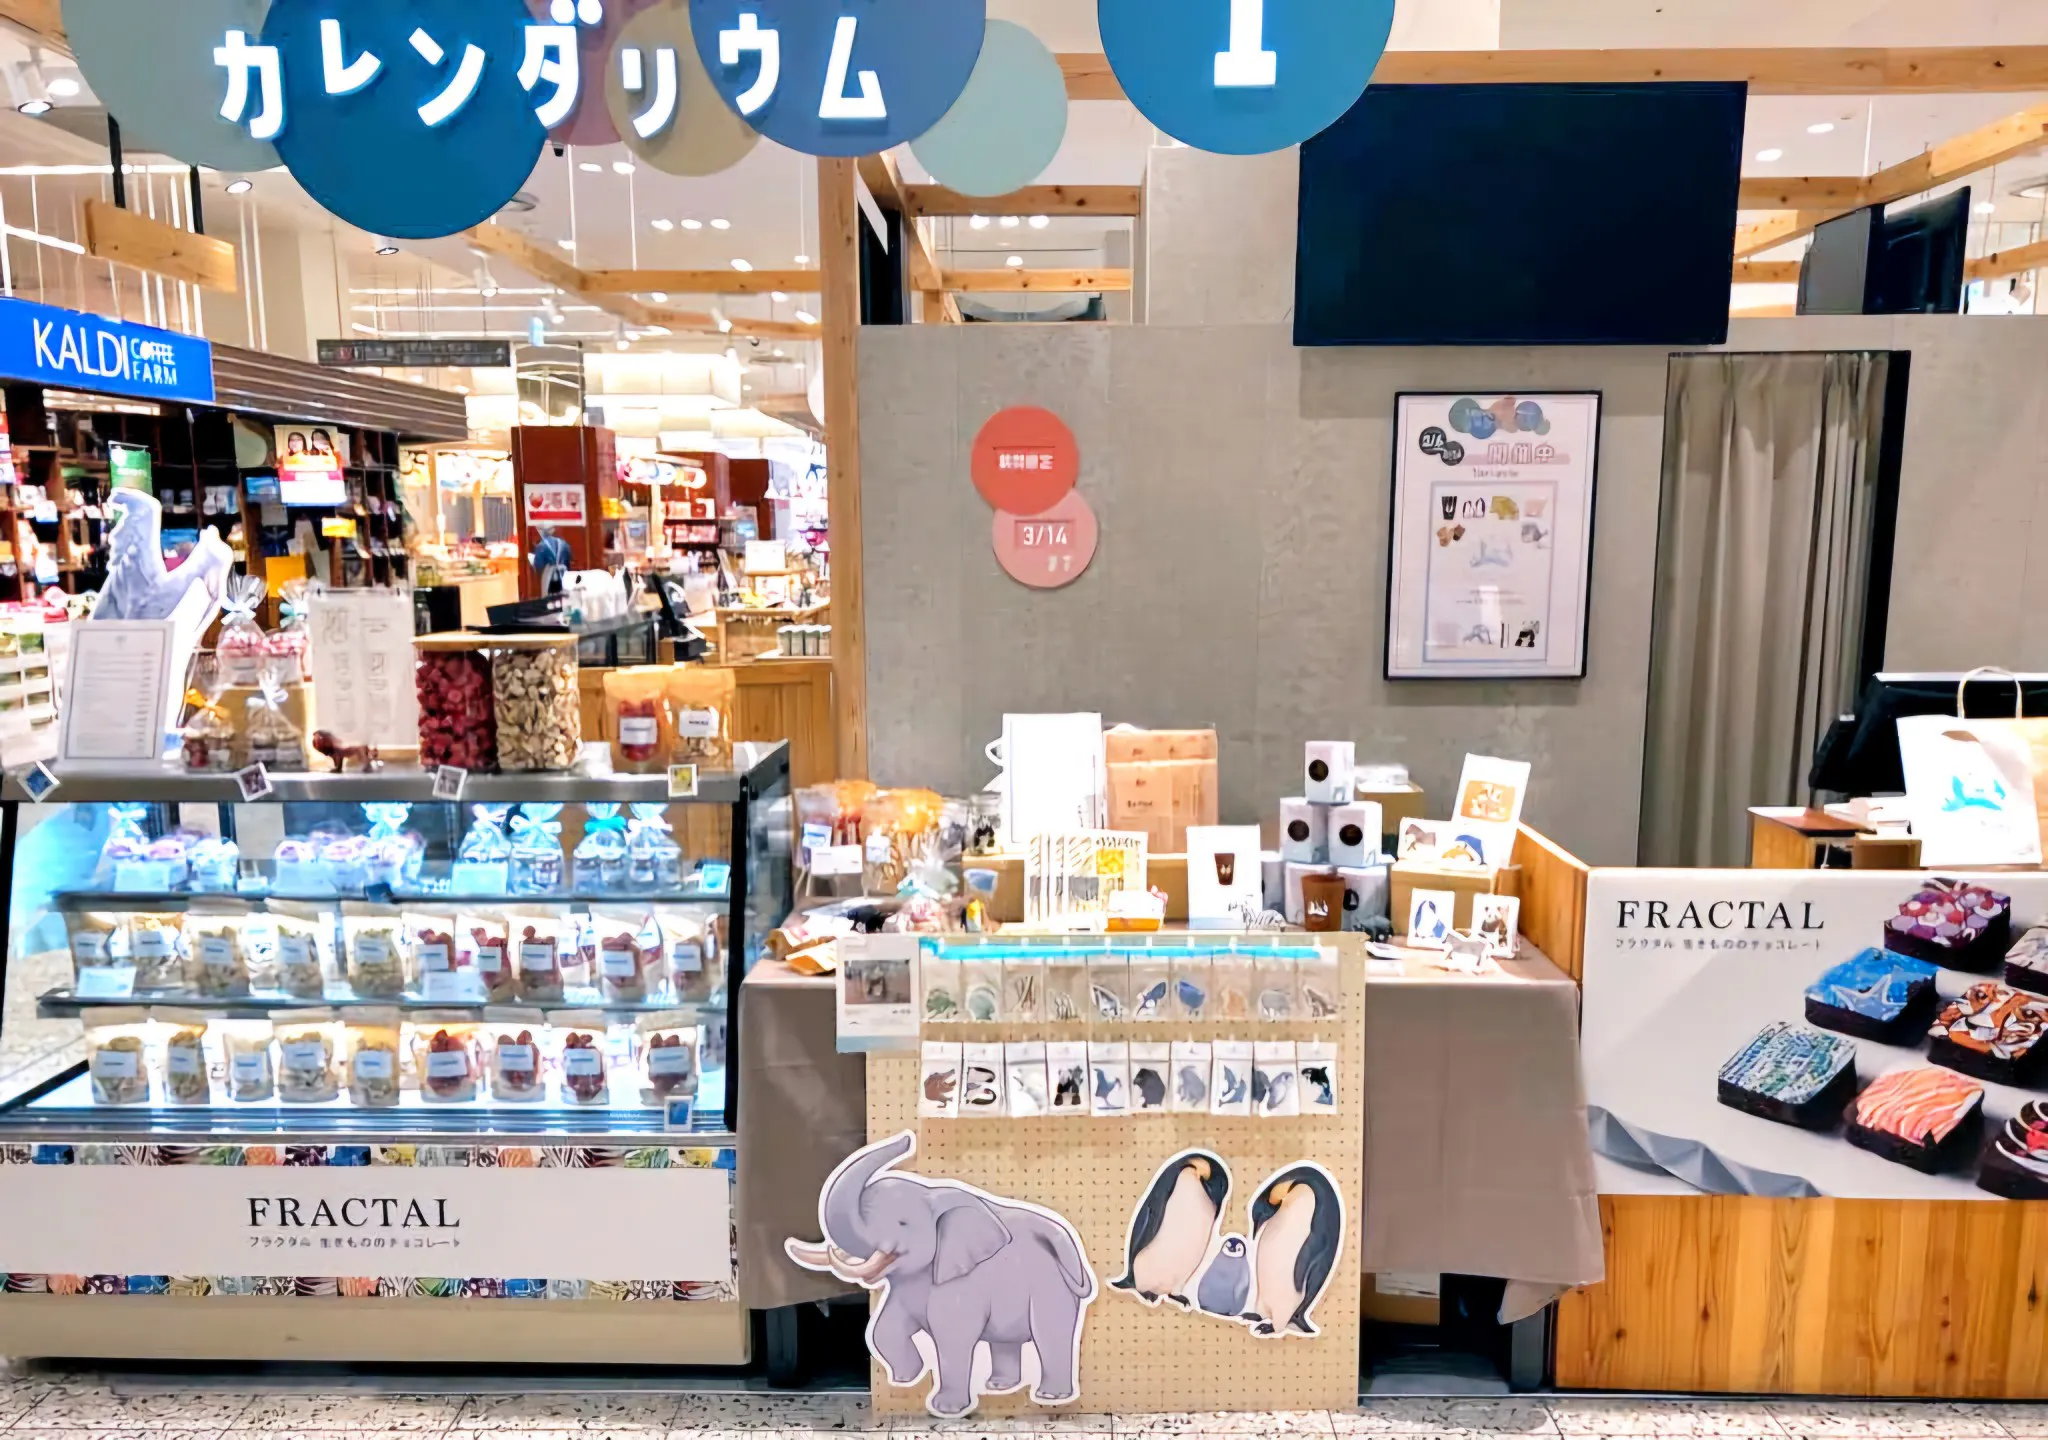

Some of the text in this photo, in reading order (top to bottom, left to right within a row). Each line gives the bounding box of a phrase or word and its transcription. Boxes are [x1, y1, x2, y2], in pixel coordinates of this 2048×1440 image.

[213, 0, 887, 140] カレンダリウム
[33, 317, 130, 381] KALDI
[130, 338, 176, 366] COFFEE
[131, 360, 178, 386] FARM
[1023, 525, 1068, 546] 3/14
[1615, 899, 1825, 930] FRACTAL
[246, 1197, 461, 1228] FRACTAL
